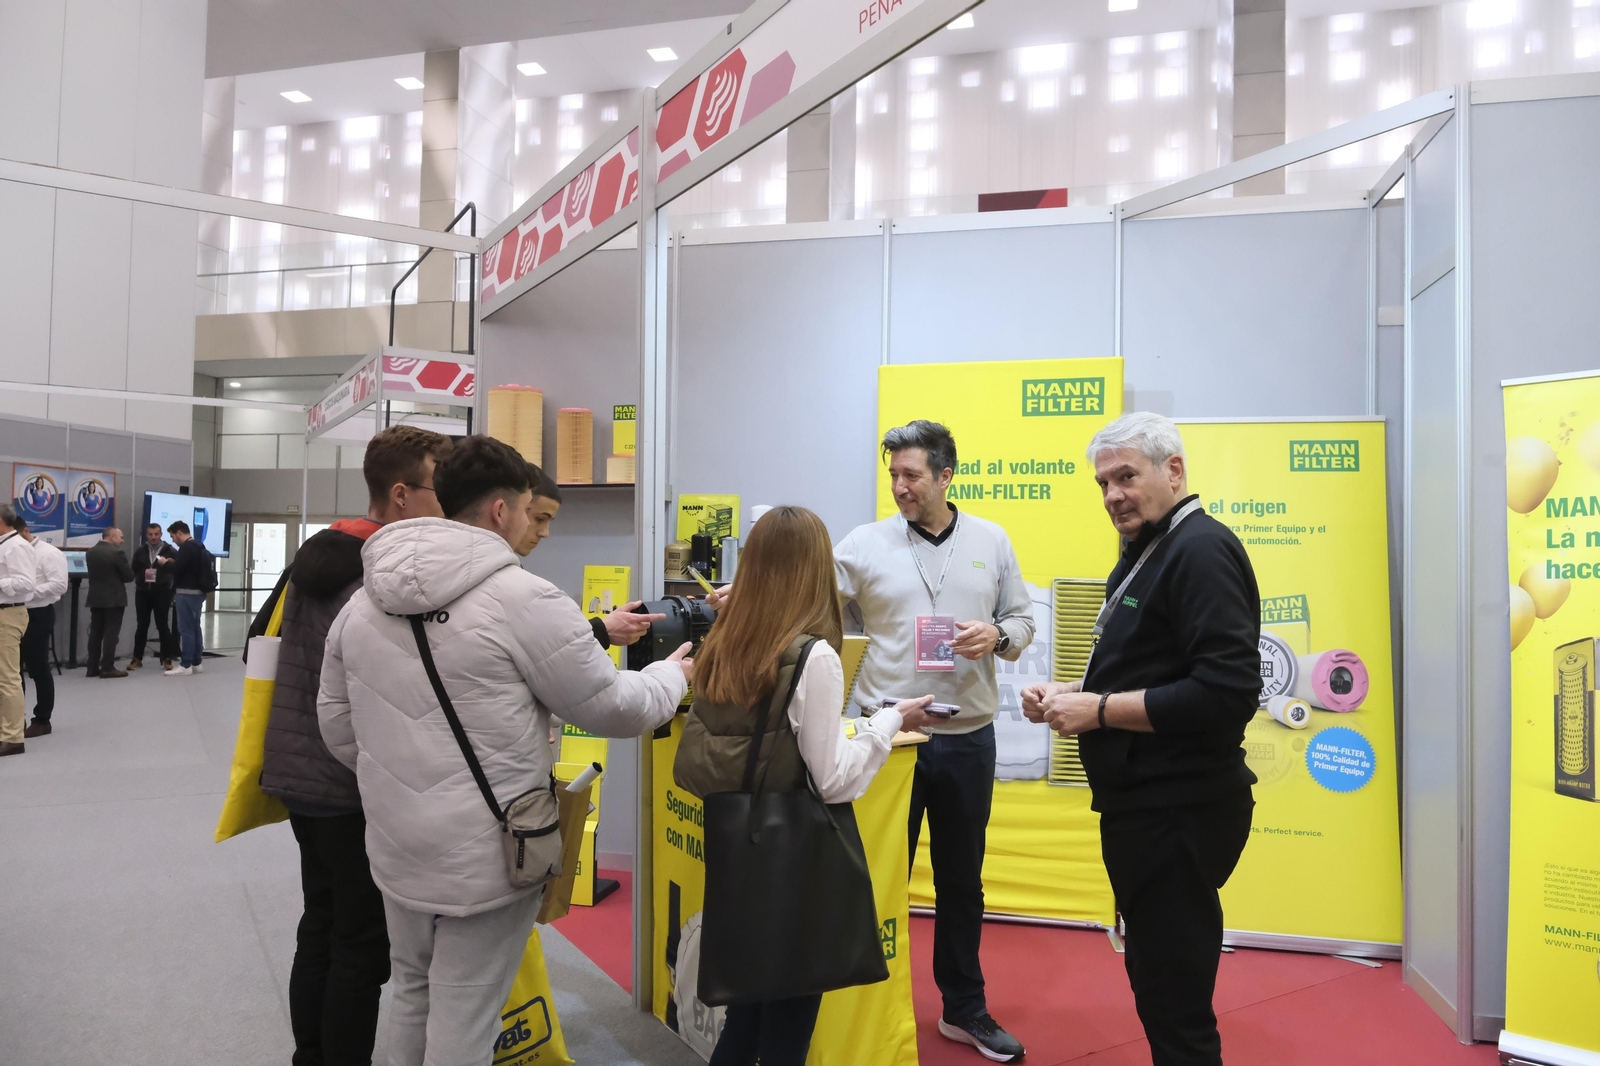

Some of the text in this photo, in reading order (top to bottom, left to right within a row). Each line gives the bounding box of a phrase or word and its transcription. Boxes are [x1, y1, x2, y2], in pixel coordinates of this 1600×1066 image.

[1026, 381, 1100, 397] MANN
[1026, 397, 1100, 413] FILTER
[1293, 443, 1355, 455] MANN
[987, 459, 1003, 475] al
[1009, 459, 1076, 475] volante
[1293, 456, 1356, 468] FILTER
[947, 484, 1051, 500] ANN-FILTER
[1209, 499, 1287, 518] el origen
[1243, 524, 1274, 533] Primer
[1276, 524, 1307, 534] Equipo
[1309, 526, 1315, 534] y
[1317, 524, 1326, 533] el
[1247, 536, 1302, 545] automoción.
[1546, 528, 1575, 549] La
[1260, 608, 1303, 622] ILTER
[1258, 641, 1278, 657] NAL
[564, 723, 587, 735] FIL
[1315, 743, 1367, 759] MANN-FILTER,
[1311, 751, 1371, 769] 100% Calidad de
[1313, 761, 1365, 777] Primer Equipo
[666, 789, 704, 828] Segurid
[1250, 826, 1325, 837] rts. Perfect service.
[666, 827, 705, 863] con MA
[881, 923, 894, 939] N
[882, 940, 894, 956] R
